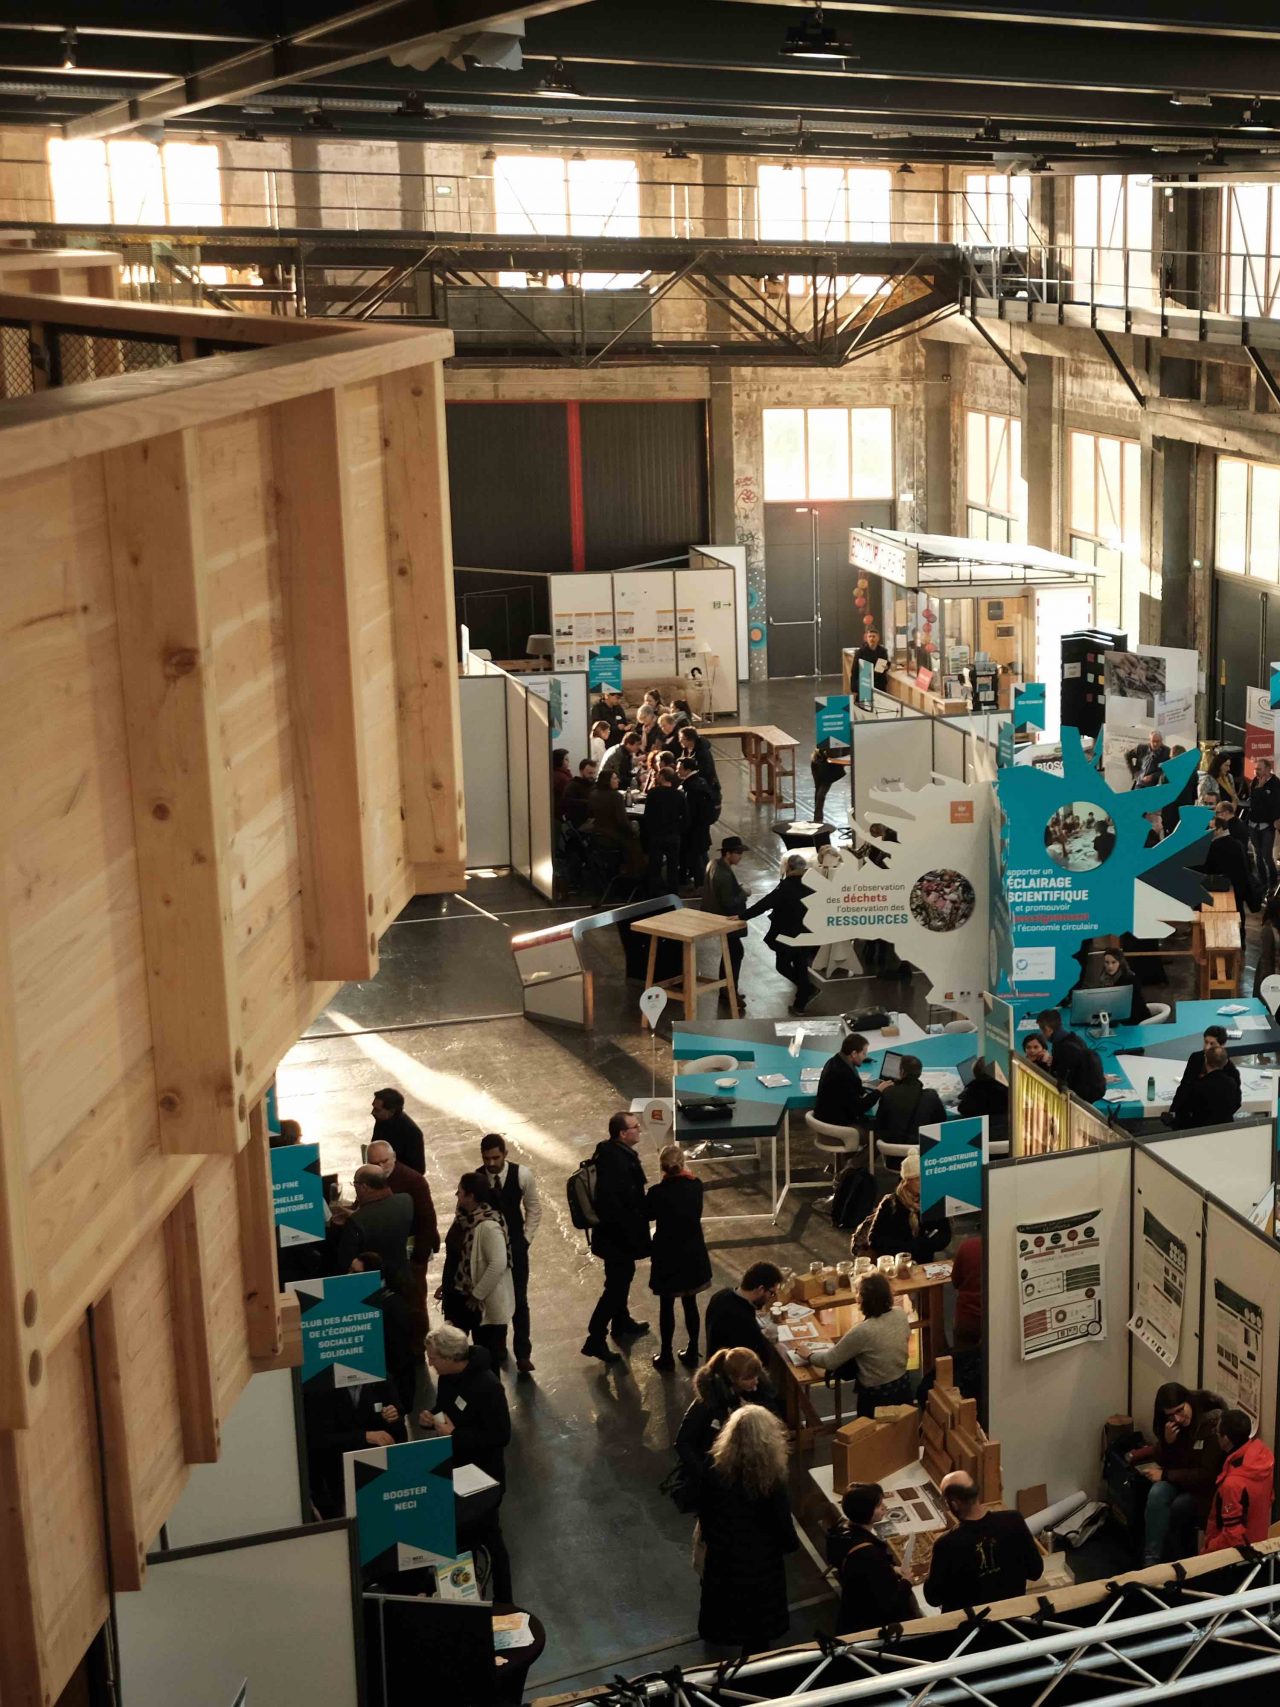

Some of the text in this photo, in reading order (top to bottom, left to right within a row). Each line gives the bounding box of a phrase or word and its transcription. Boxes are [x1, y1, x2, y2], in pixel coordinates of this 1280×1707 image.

[1007, 868, 1041, 877] apporter
[853, 883, 906, 892] l'observation
[1007, 875, 1072, 889] ÉCLAIRAGE
[826, 893, 887, 904] des déchets
[1007, 889, 1089, 903] SCIENTIFIQUE
[837, 903, 905, 913] l'observation des
[1015, 904, 1071, 913] et promouvoir
[826, 913, 909, 927] RESSOURCES
[1017, 922, 1099, 932] l'économie circulaire
[924, 1151, 978, 1166] ÉCO-CONSTRUIRE
[925, 1160, 977, 1176] ET ÉCO-RÉNOVER
[282, 1180, 299, 1189] FINE
[301, 1310, 380, 1328] CLUB DES ACTEURS
[309, 1323, 372, 1339] DE L'ÉCONOMIE
[318, 1335, 364, 1348] SOCIALE ET
[320, 1346, 364, 1359] SOLIDAIRE
[383, 1486, 428, 1500] BOOSTER
[394, 1501, 417, 1511] NECI
